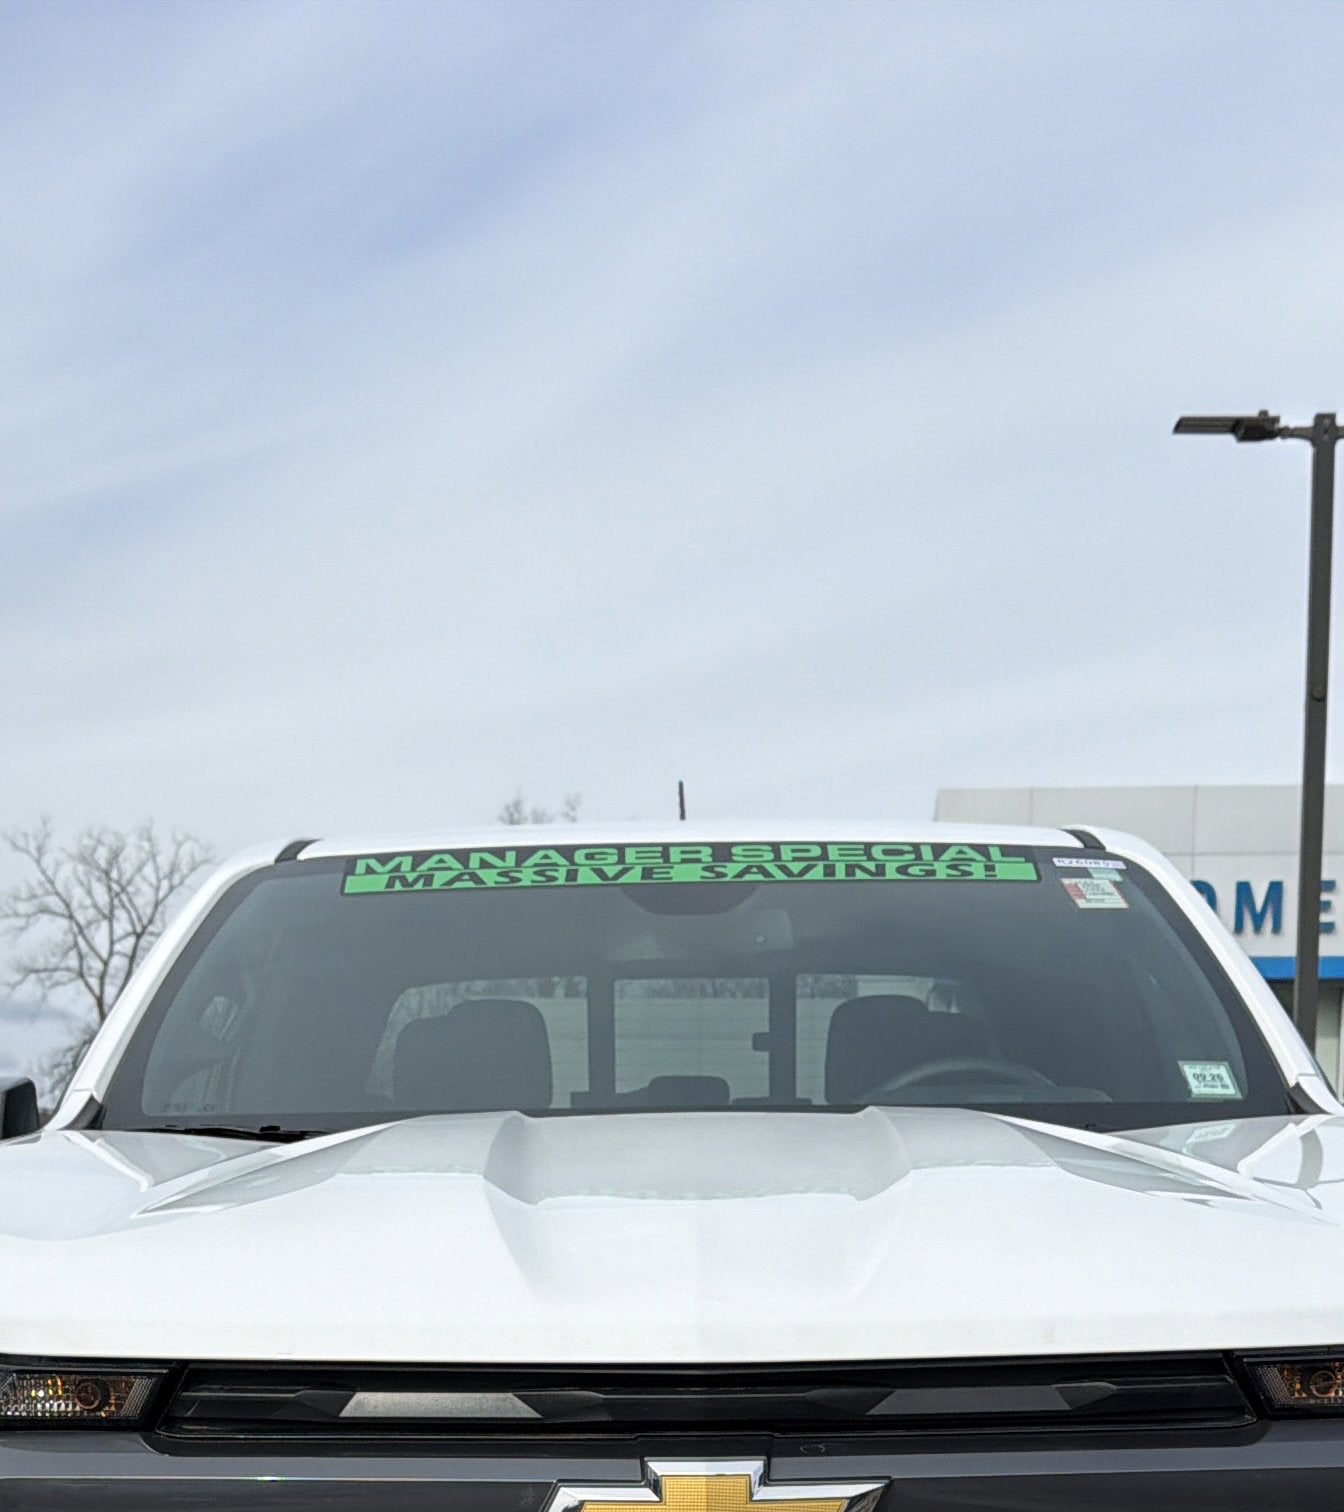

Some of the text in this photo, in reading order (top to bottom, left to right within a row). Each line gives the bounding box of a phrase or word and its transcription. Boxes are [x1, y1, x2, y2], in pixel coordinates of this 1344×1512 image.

[355, 844, 1026, 875] MANAGER SPECIAL
[384, 863, 997, 890] MASSIVE SAVINGS!
